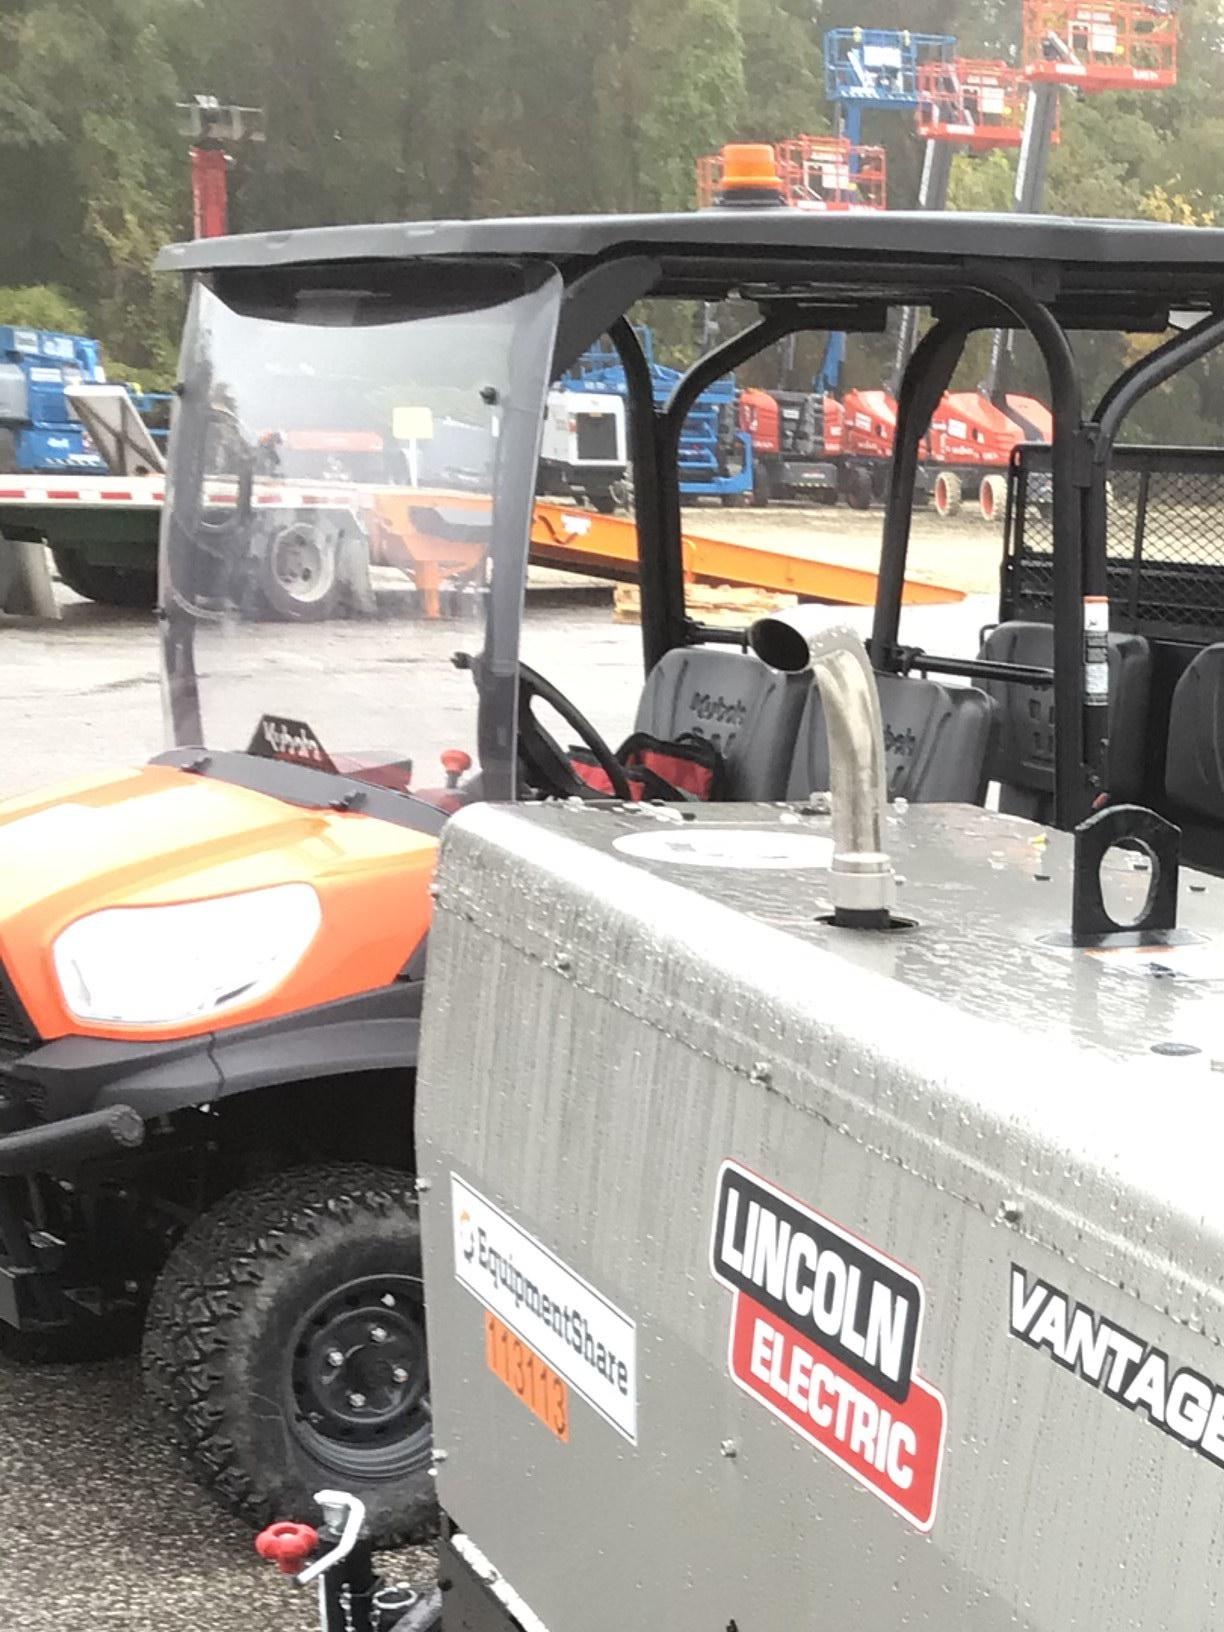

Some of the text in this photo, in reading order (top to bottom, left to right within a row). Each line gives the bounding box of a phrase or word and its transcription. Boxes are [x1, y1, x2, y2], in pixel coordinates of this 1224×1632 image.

[476, 1229, 630, 1397] EquipmentShare
[720, 1187, 909, 1382] LINCOLN
[750, 1317, 917, 1490] ELECTRIC
